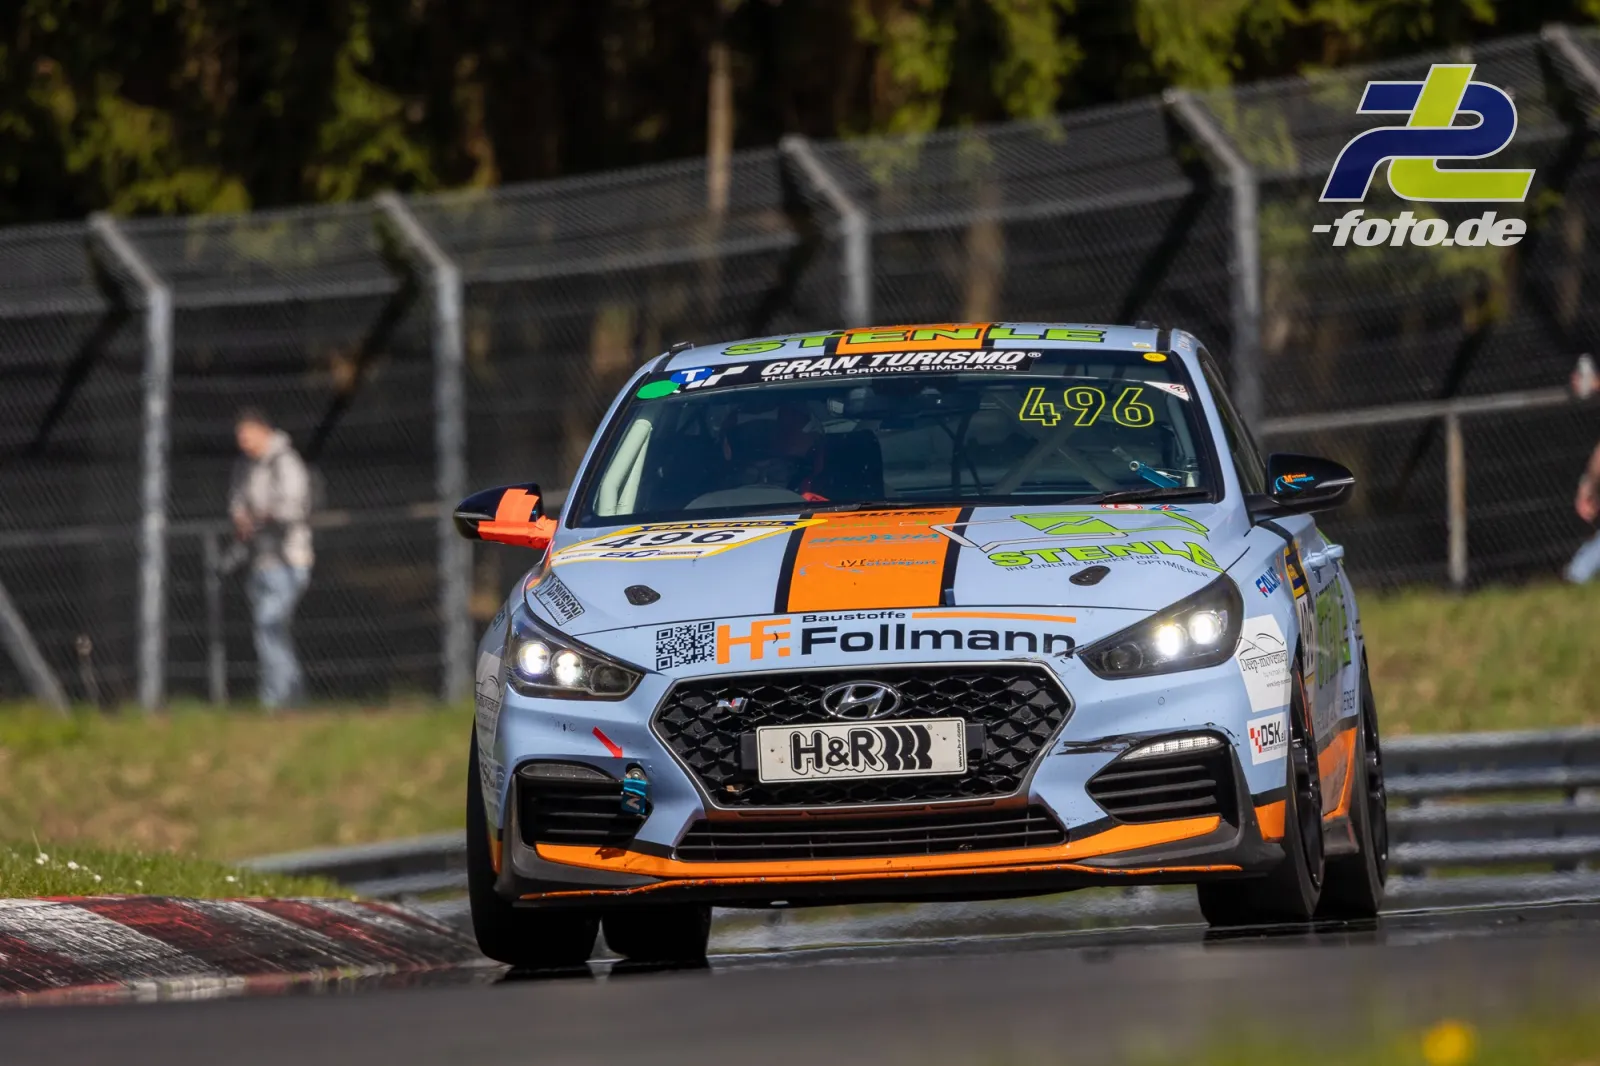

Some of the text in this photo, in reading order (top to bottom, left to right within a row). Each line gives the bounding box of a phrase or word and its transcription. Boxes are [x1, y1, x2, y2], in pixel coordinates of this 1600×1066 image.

[722, 326, 1107, 356] STENLE
[760, 351, 1026, 376] GRAN TURISMO
[760, 373, 794, 382] THE
[798, 369, 842, 379] REAL
[846, 366, 915, 374] DRIVING
[1018, 386, 1155, 427] 496
[592, 529, 746, 549] 496
[987, 540, 1225, 574] STENLE
[1030, 561, 1080, 570] ONLINE
[1083, 554, 1161, 566] MARKETING
[1136, 559, 1210, 579] OPTIMIERER
[801, 611, 906, 624] Baustoffe
[800, 623, 1077, 659] Follmann
[1260, 721, 1281, 747] DSK
[791, 729, 880, 772] H&R
